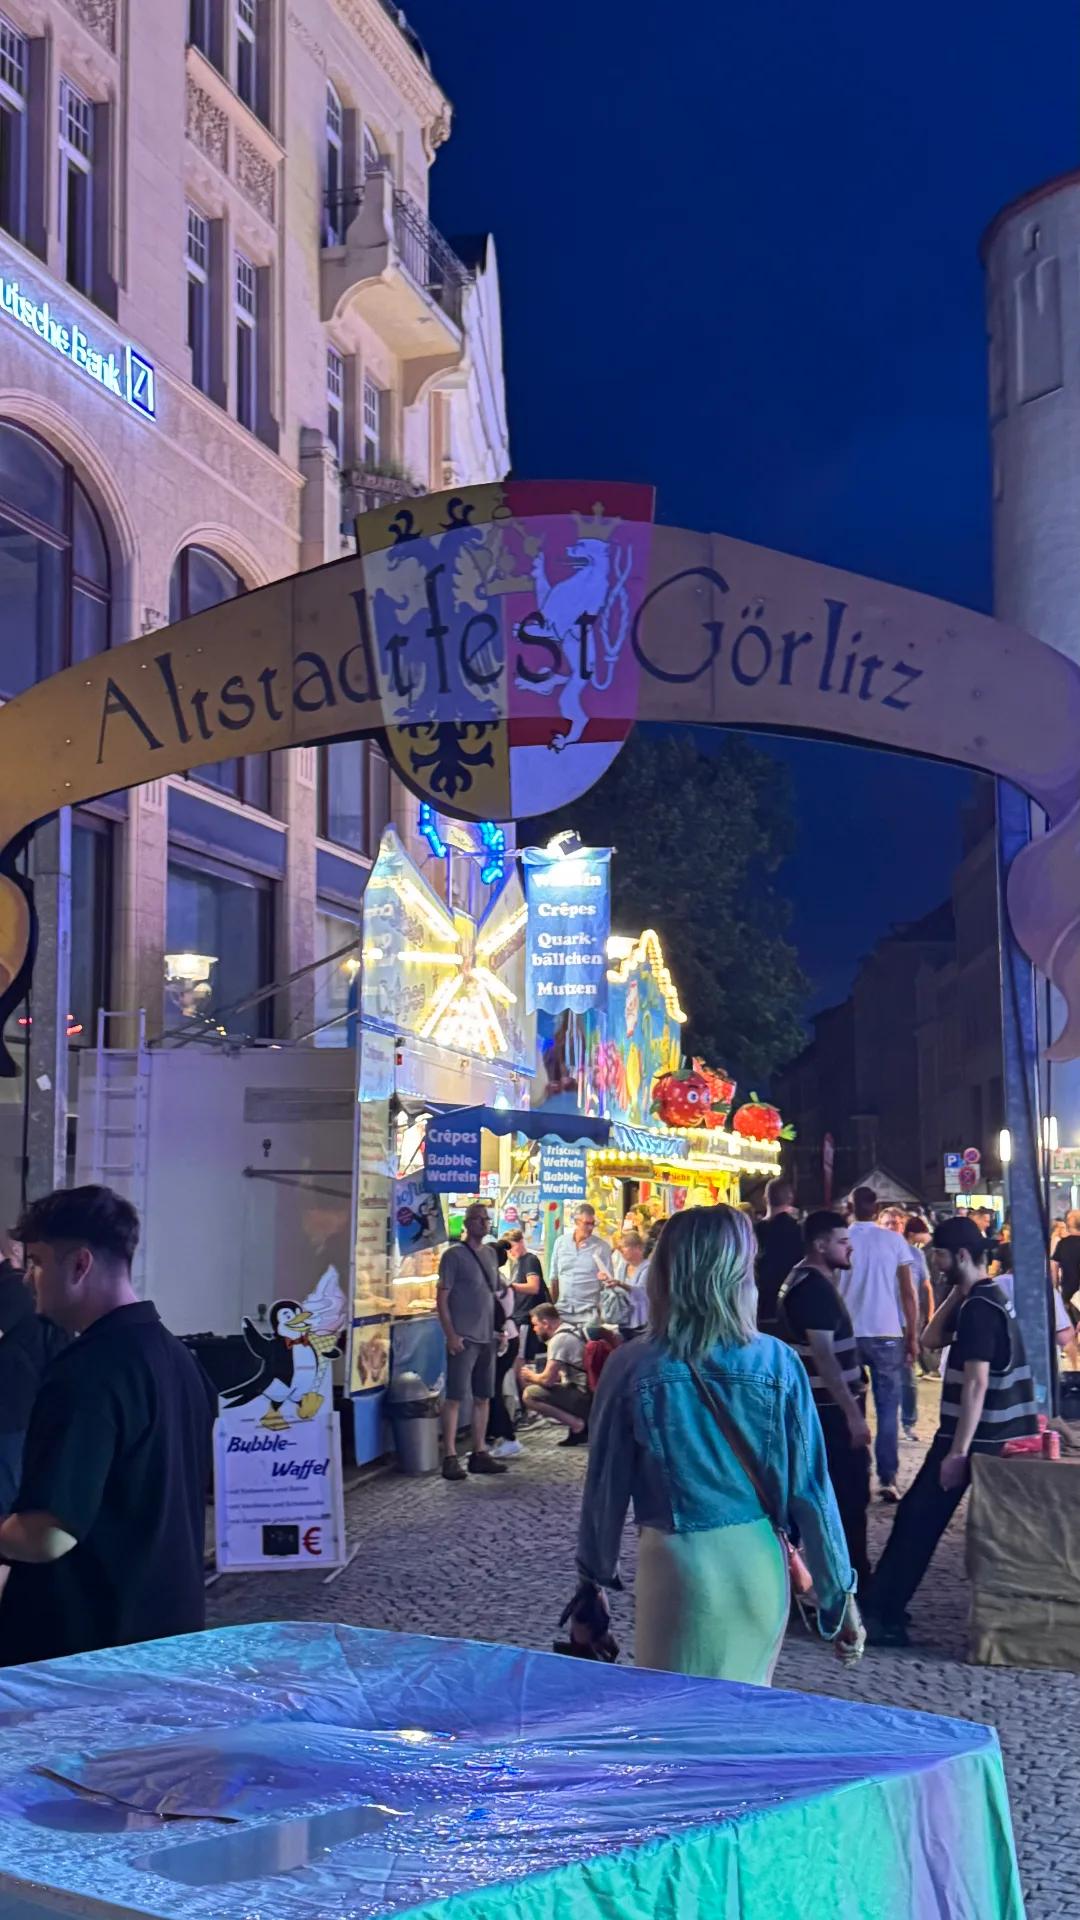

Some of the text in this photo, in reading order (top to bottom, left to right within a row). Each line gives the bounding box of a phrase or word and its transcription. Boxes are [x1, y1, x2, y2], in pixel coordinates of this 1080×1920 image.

[71, 324, 122, 397] Bank
[95, 563, 924, 765] Altstadtfest Görlitz
[537, 902, 597, 918] Crêpes
[537, 932, 598, 949] Quark-
[531, 952, 604, 966] bällchen
[428, 1129, 478, 1146] Crêpes
[947, 1155, 957, 1167] P
[227, 1435, 297, 1453] Bubble-
[271, 1458, 330, 1479] Waffel
